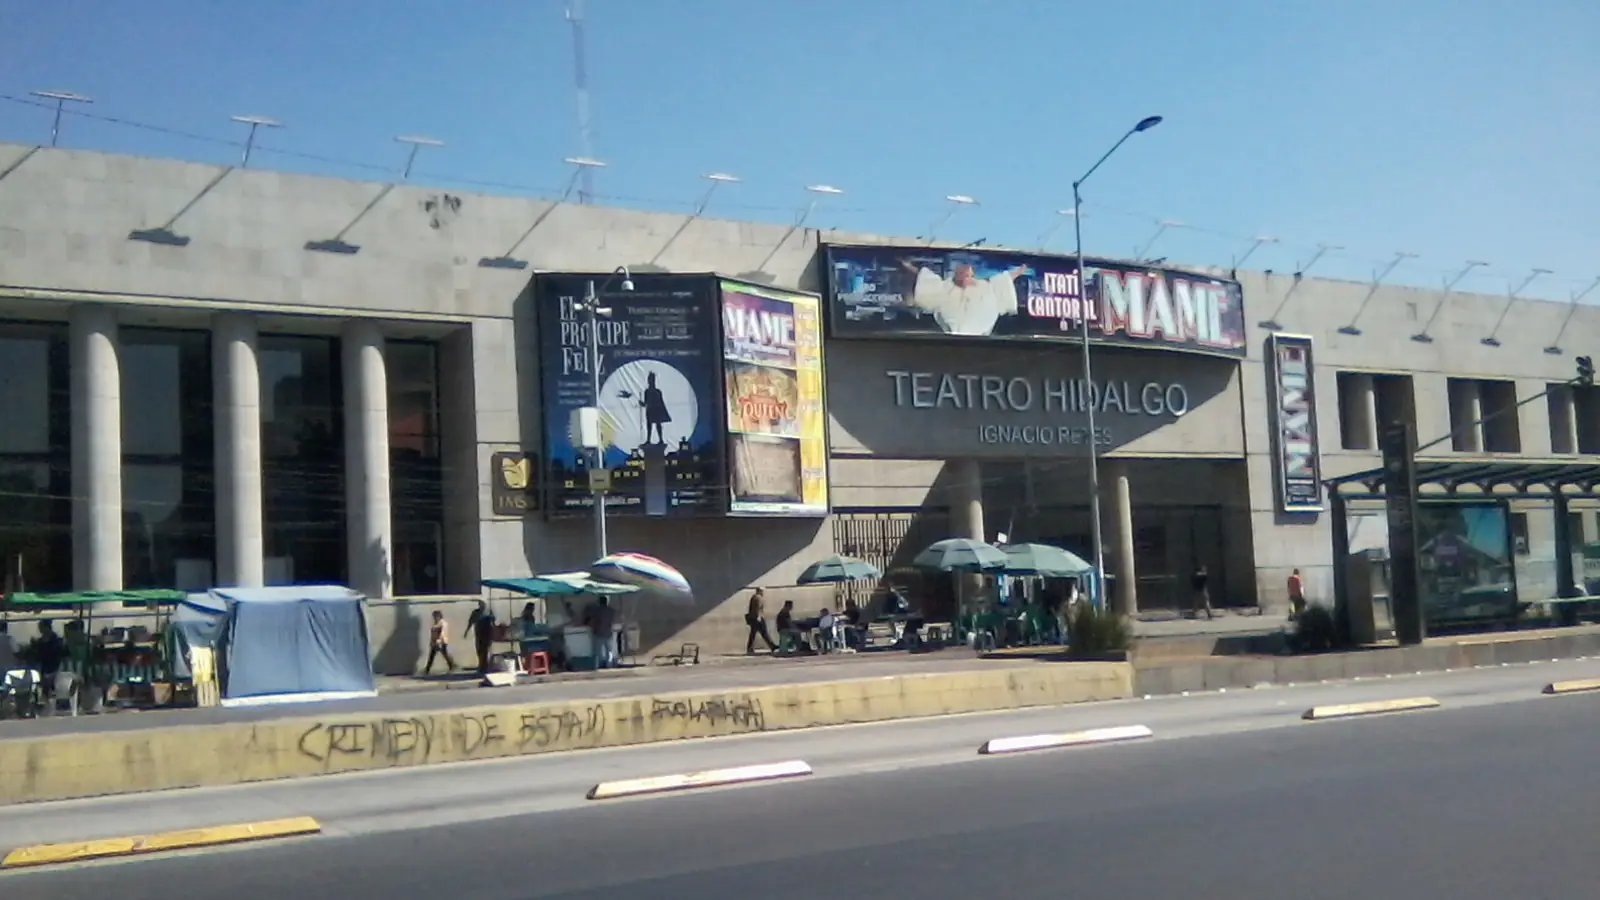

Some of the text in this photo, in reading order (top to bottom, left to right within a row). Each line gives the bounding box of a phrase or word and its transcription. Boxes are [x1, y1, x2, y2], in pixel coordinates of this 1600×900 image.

[559, 295, 577, 320] EL
[886, 370, 1188, 417] TEATRO HIDALGO
[979, 424, 1054, 445] IGNACIO
